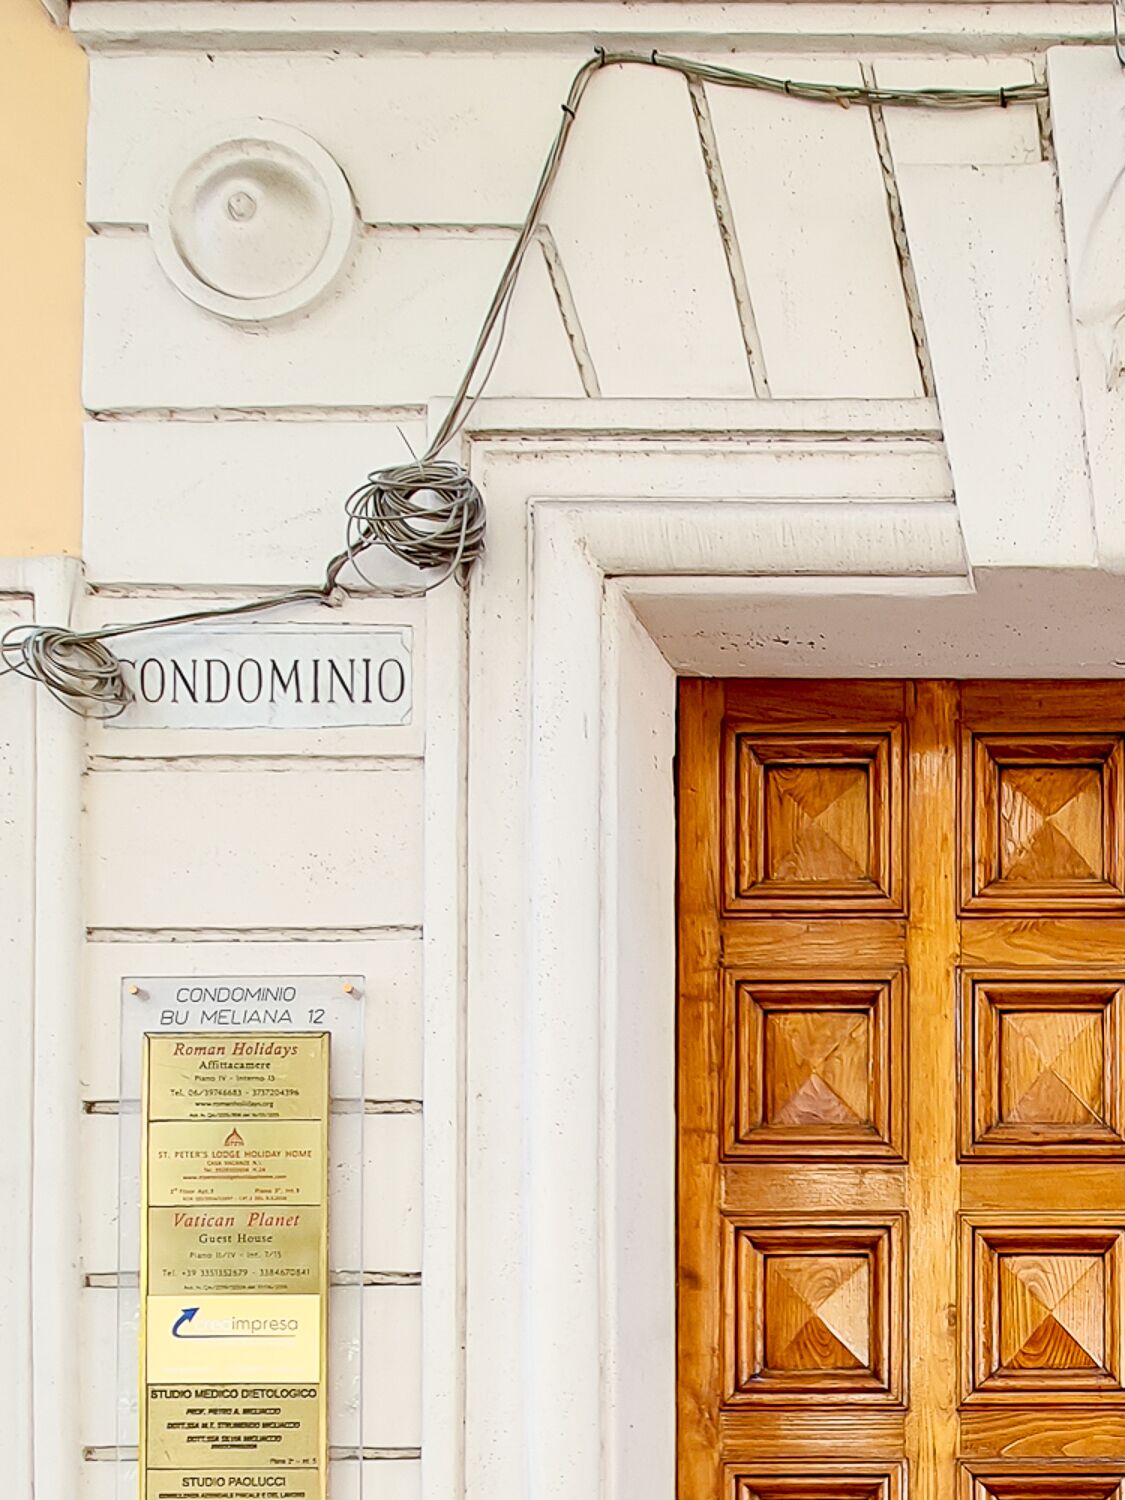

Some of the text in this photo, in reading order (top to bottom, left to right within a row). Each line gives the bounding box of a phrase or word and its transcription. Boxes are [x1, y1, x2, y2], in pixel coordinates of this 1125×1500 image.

[176, 987, 296, 1002] CONDOMINIO
[160, 1009, 325, 1025] BU MELIANA 12
[174, 1042, 298, 1058] Roman Holidays
[199, 1061, 271, 1070] Affittacamere
[175, 1151, 208, 1159] PETER'S
[285, 1150, 312, 1158] HOME
[174, 1212, 300, 1228] Vatican Planet
[199, 1233, 273, 1243] Guest House
[232, 1316, 298, 1333] impresa
[151, 1389, 317, 1399] STUDIO MEDICO DIETOLOGICO
[182, 1477, 285, 1487] STUDIO PAOLUCCI
